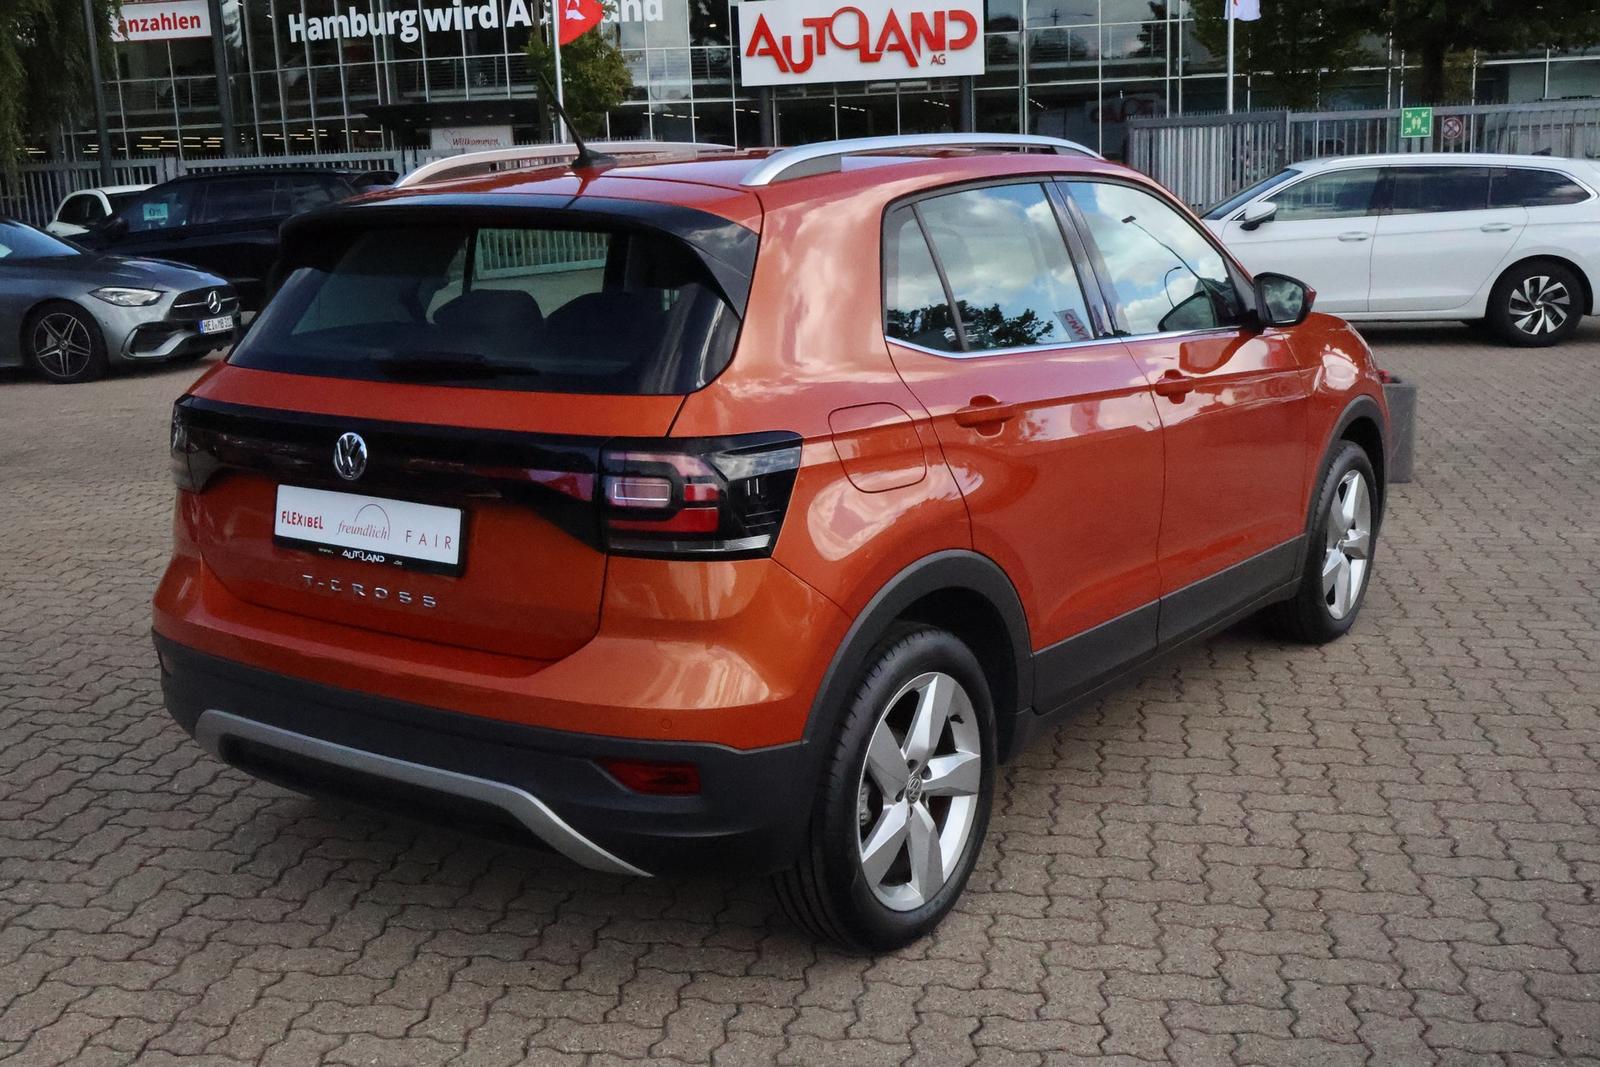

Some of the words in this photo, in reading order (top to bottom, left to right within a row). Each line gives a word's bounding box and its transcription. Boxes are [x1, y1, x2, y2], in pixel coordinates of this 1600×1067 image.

[288, 6, 419, 43] Hamburg
[423, 0, 499, 32] wird
[930, 54, 946, 66] AG
[281, 511, 324, 530] FLEXIBEL
[336, 520, 391, 541] freundlich
[405, 530, 453, 550] FAIR
[302, 574, 437, 608] T-CROSS
